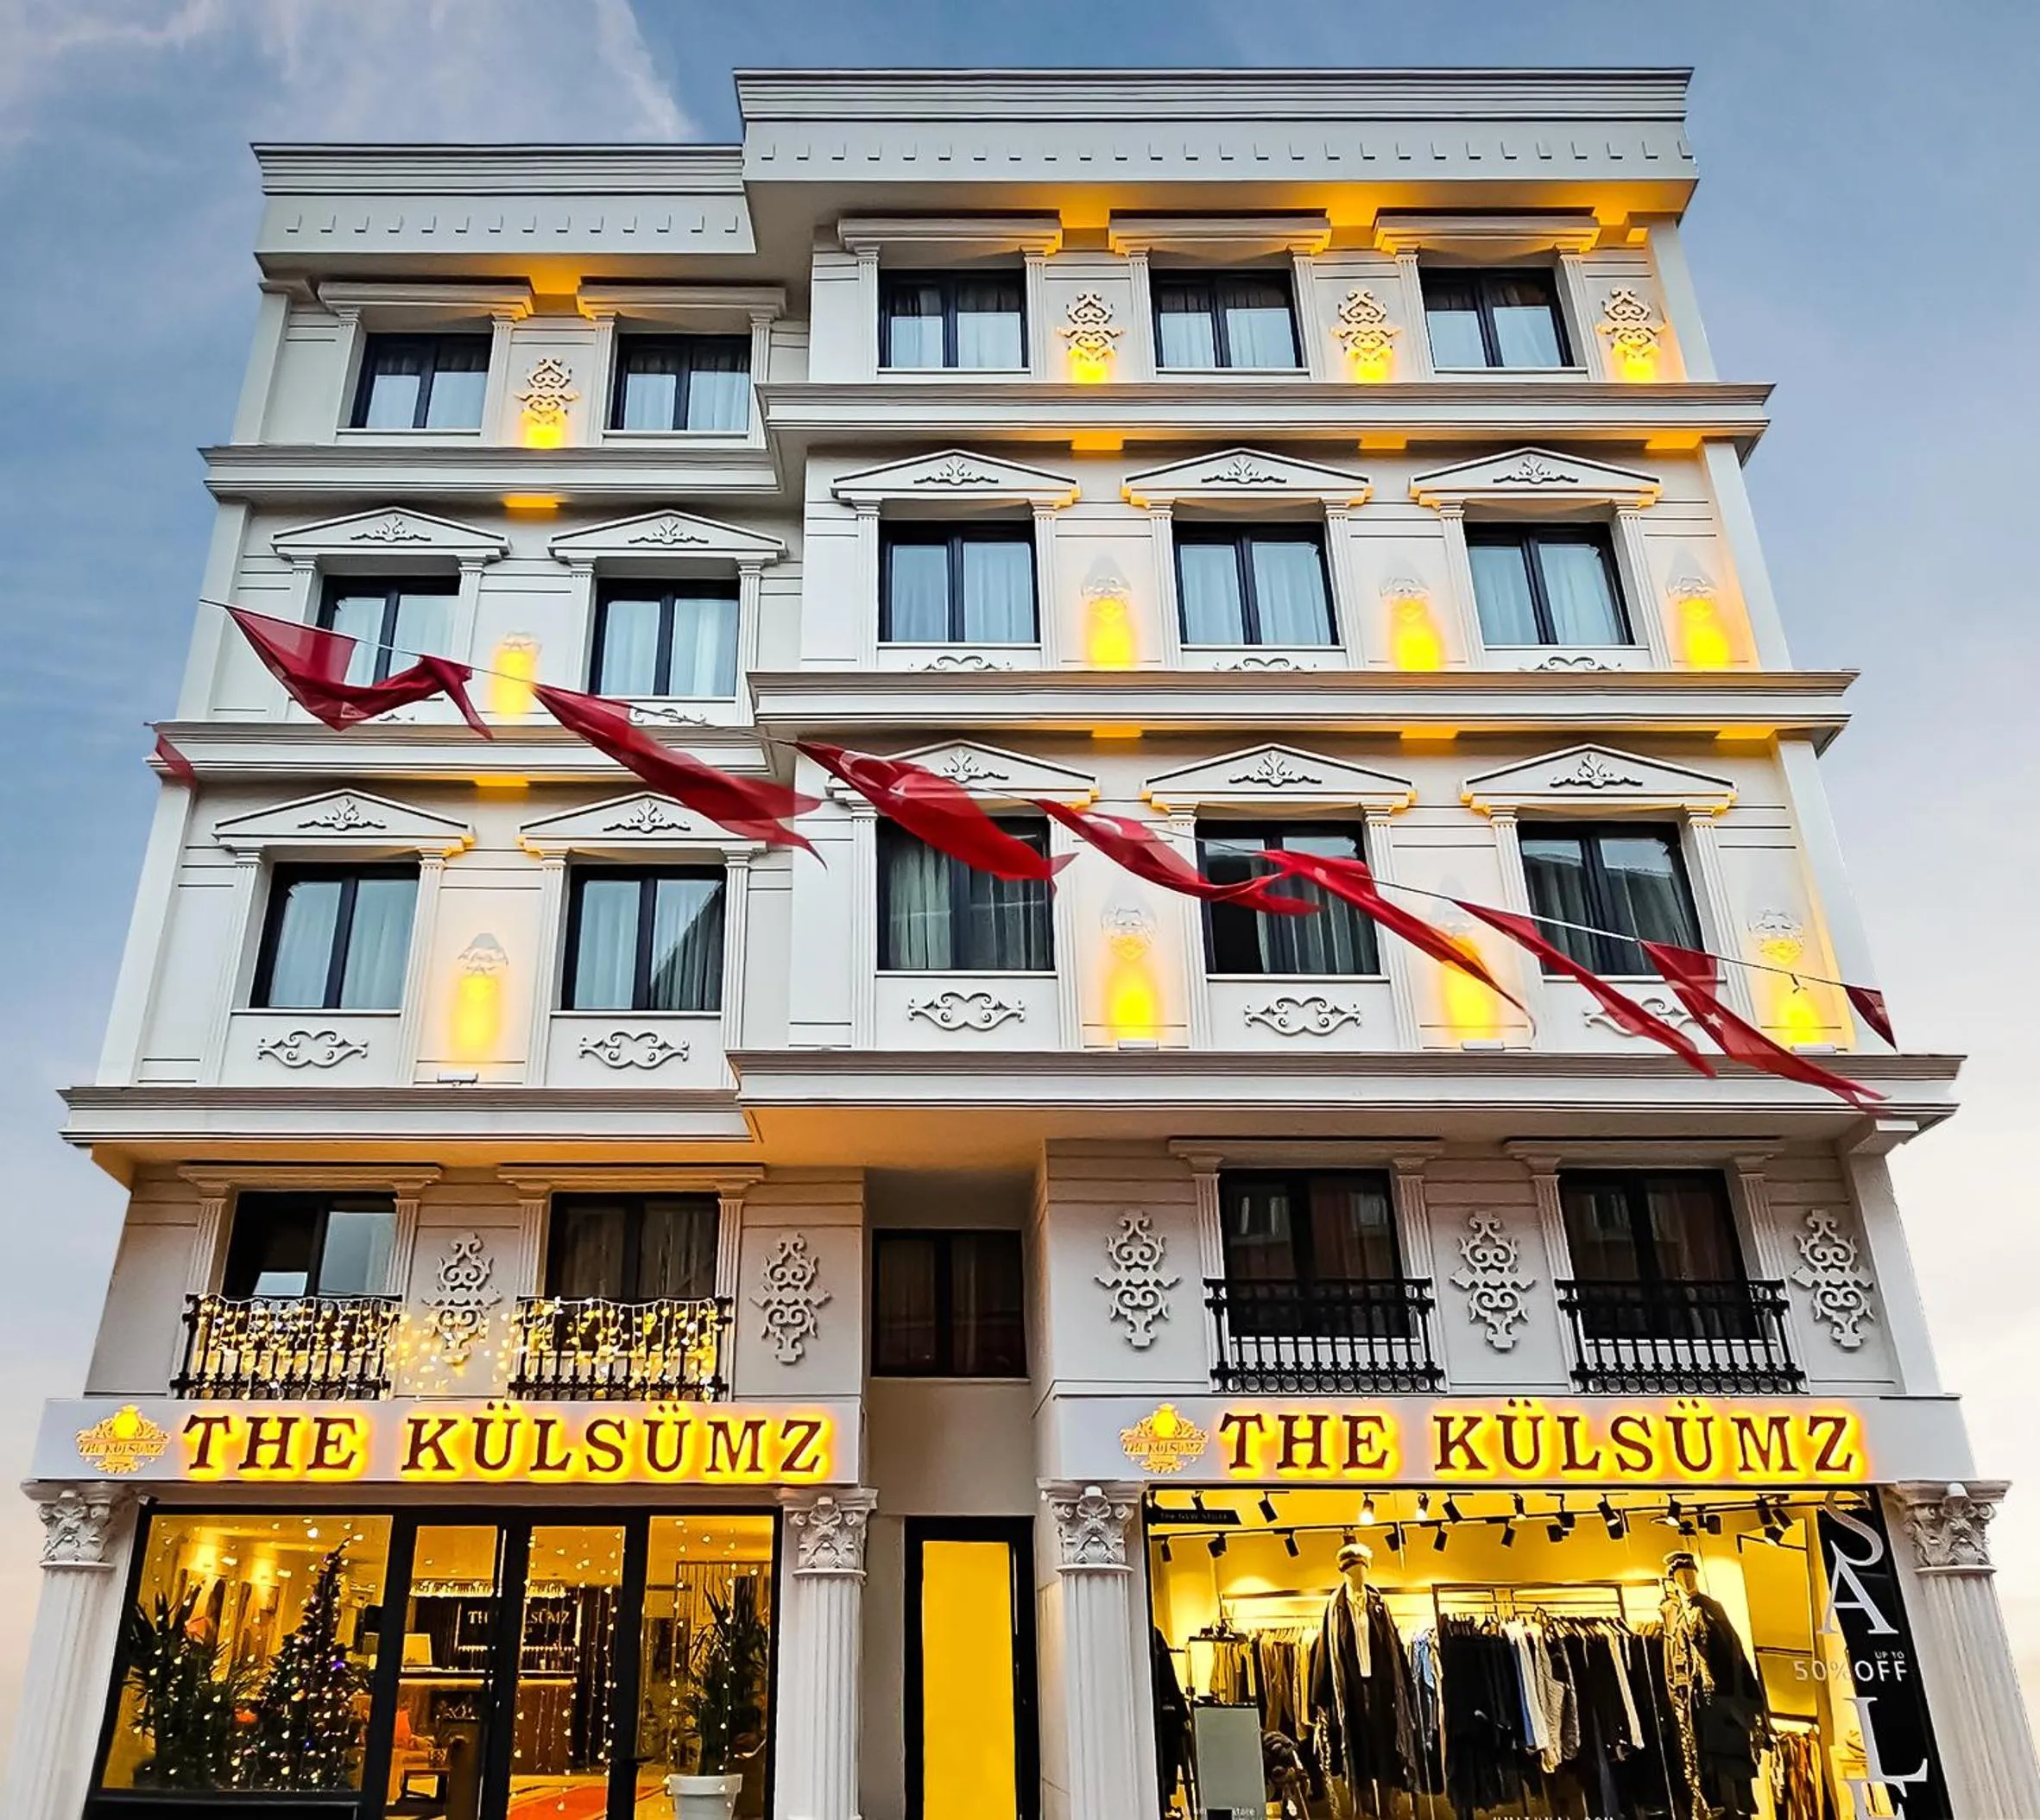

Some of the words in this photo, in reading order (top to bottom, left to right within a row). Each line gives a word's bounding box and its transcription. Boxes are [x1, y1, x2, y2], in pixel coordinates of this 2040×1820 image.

[183, 1414, 358, 1472] THE
[401, 1401, 823, 1473] KÜLSÜMZ
[1219, 1412, 1389, 1470] THE
[1433, 1398, 1855, 1473] KÜLSÜMZ
[1874, 1650, 1889, 1659] UP
[1891, 1650, 1905, 1659] TO
